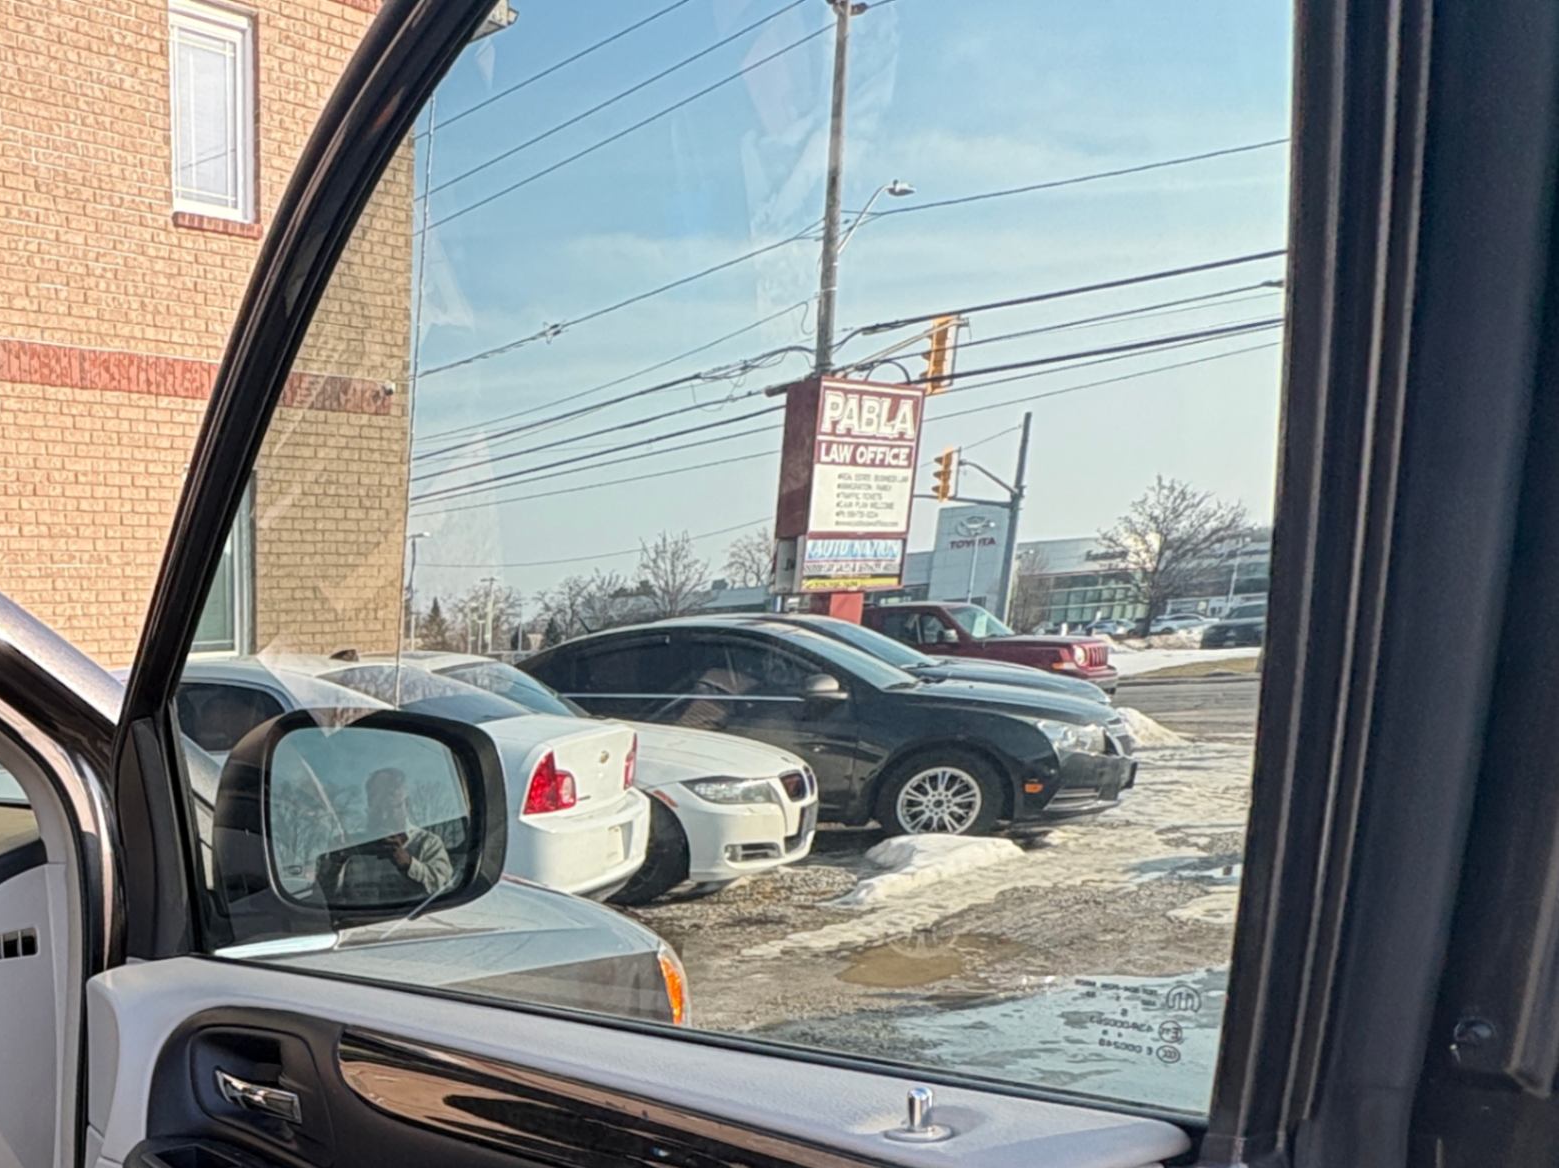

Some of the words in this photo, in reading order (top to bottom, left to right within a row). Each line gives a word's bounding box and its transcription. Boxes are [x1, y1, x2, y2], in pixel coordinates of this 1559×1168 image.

[821, 390, 915, 439] PABLA
[820, 443, 854, 463] LAW
[856, 445, 910, 466] OFFICE
[950, 537, 996, 549] TOYOTA
